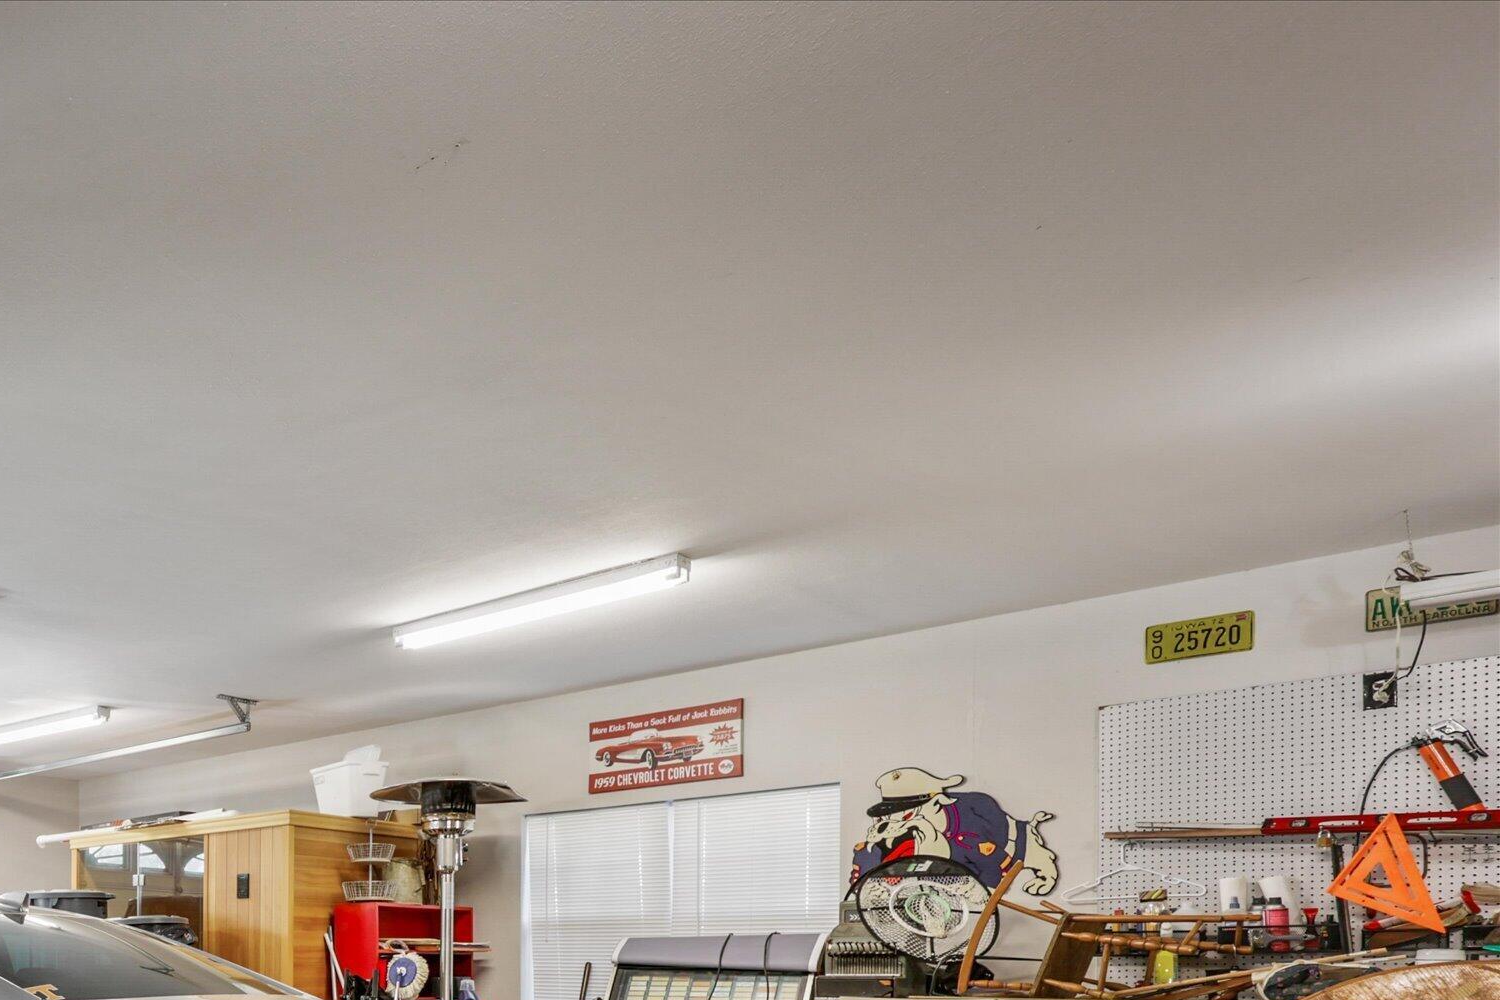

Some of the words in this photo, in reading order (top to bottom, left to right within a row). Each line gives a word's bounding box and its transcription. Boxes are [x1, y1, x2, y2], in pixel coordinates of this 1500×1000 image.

[1174, 624, 1241, 653] 25720
[592, 726, 608, 735] More
[608, 723, 626, 733] Kicks
[627, 720, 643, 730] Than
[650, 717, 667, 726] Sack
[668, 715, 681, 723] Full
[682, 713, 691, 721] of
[691, 711, 708, 720] Jack
[710, 706, 738, 717] Rabbits
[594, 776, 616, 788] 1959
[617, 769, 666, 787] CHEVROLET
[667, 762, 714, 780] CORVETTE
